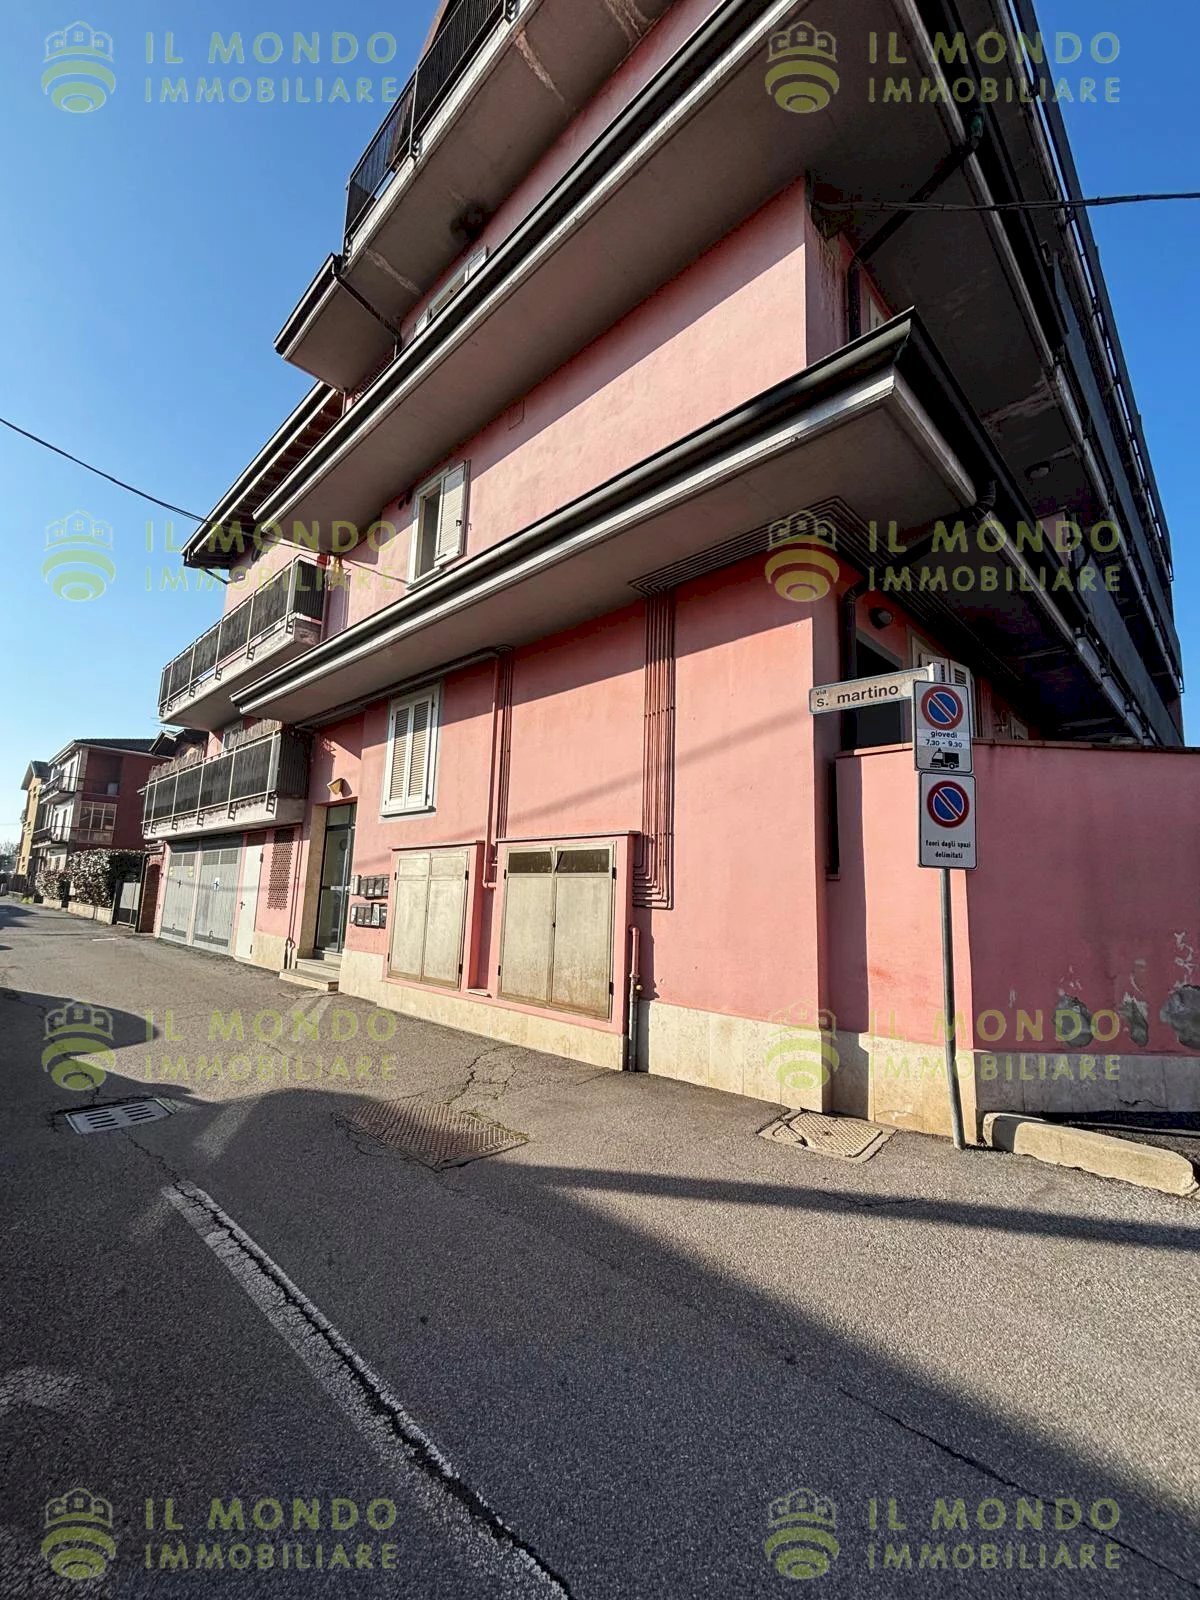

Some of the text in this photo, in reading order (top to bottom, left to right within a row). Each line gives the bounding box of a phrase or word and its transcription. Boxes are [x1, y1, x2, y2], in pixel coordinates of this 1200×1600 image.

[815, 688, 828, 696] via
[816, 685, 899, 708] s. martino
[935, 851, 963, 859] delimitati
